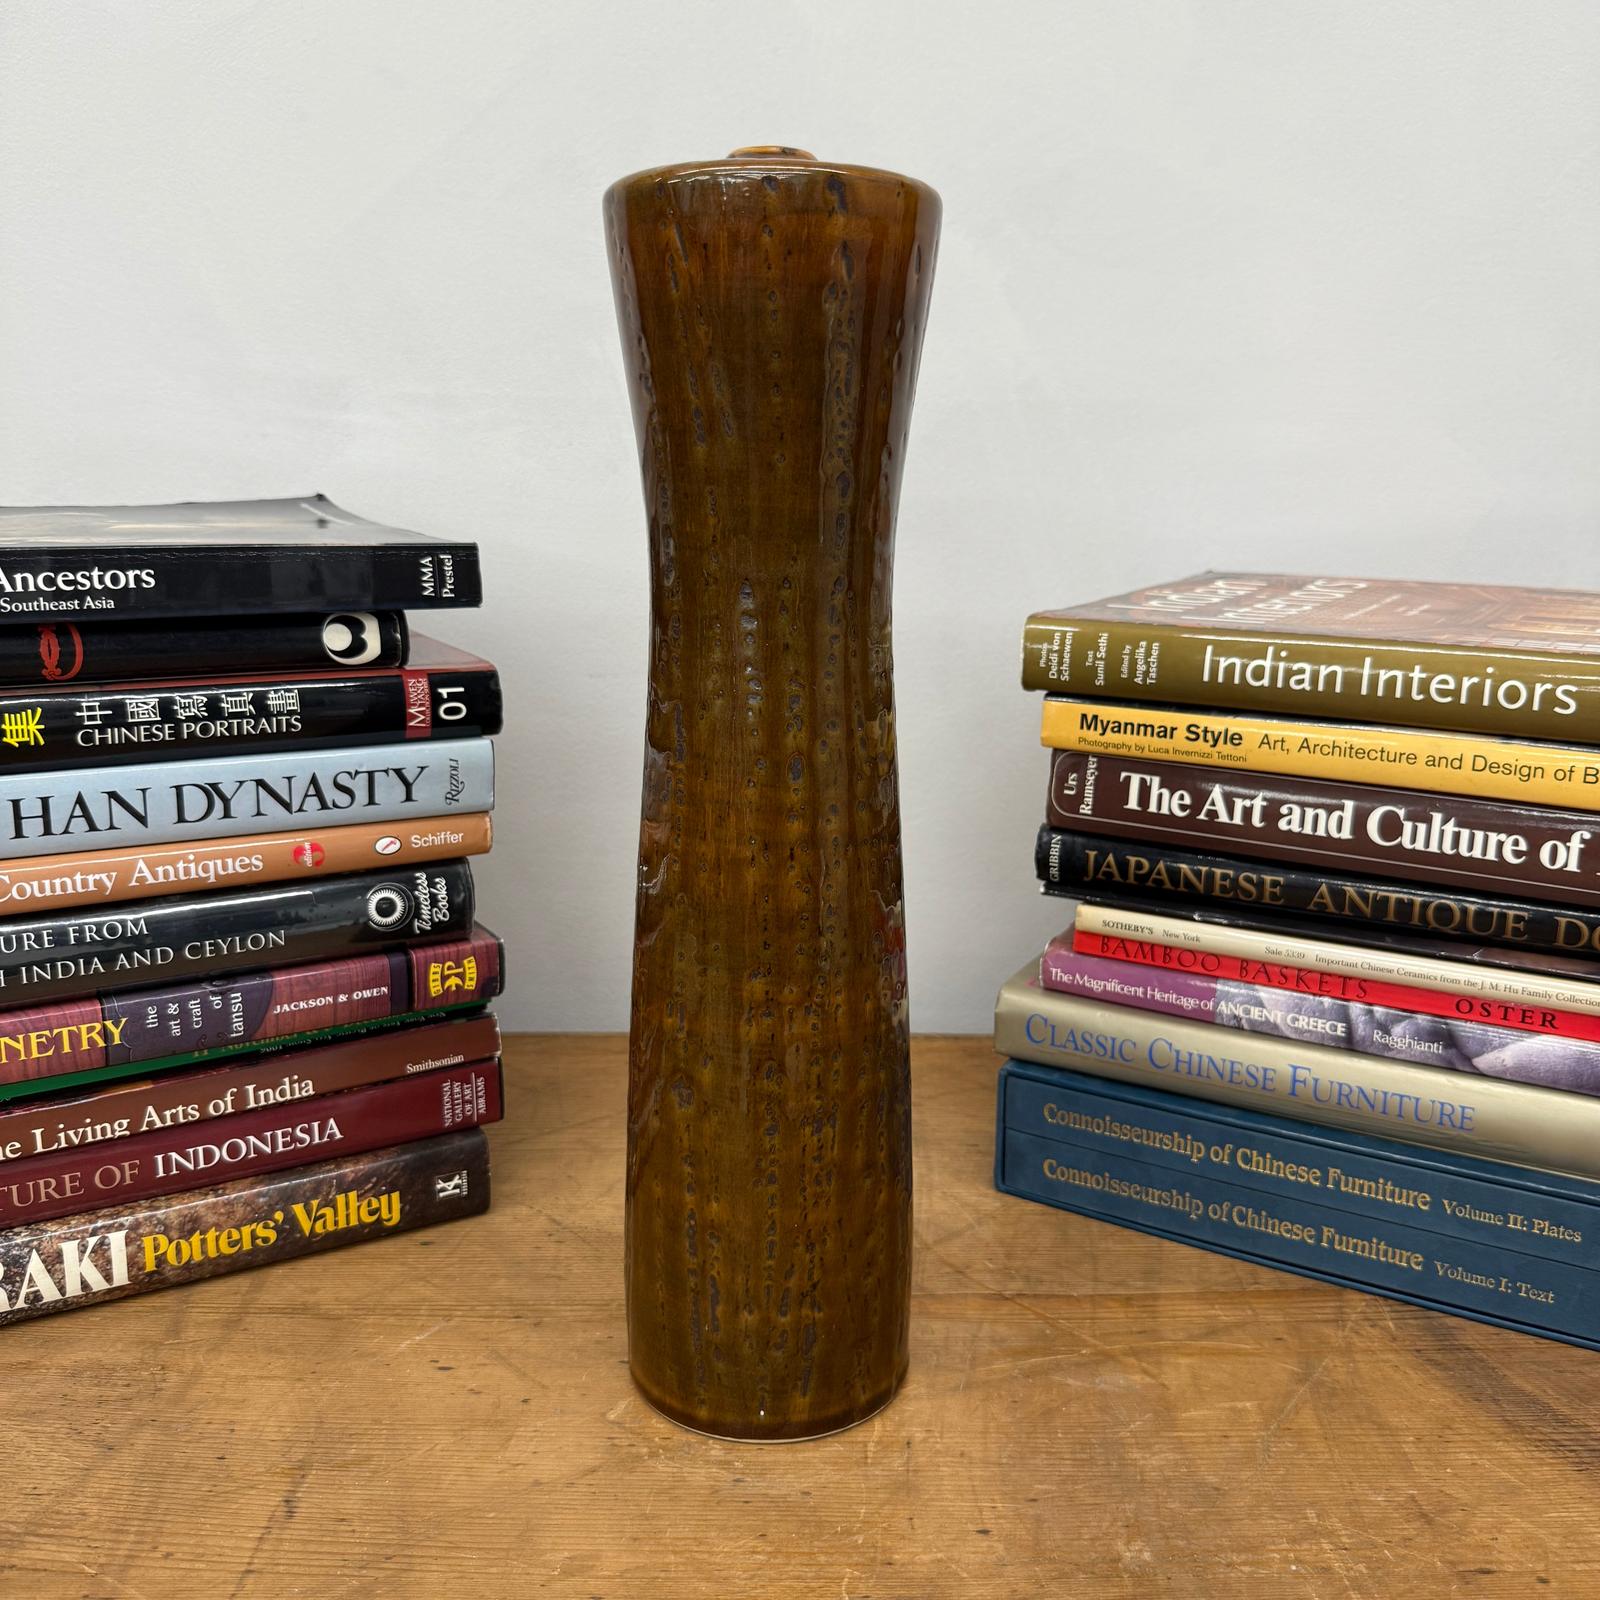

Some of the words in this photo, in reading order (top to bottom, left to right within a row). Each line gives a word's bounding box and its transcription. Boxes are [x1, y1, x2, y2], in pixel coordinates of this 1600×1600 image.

[420, 555, 435, 597] MMA
[439, 553, 455, 598] Prestel
[0, 597, 80, 612] Southeast
[83, 595, 115, 609] Asia
[1052, 632, 1061, 652] von
[1060, 631, 1073, 682] Schaewen
[1096, 632, 1109, 658] Sethi
[1134, 640, 1147, 685] Angelika
[1048, 653, 1059, 679] Deidi
[1095, 660, 1105, 686] Sunil
[1121, 654, 1130, 679] Edited
[1147, 642, 1160, 686] Taschen
[1201, 645, 1343, 694] Indian
[1360, 656, 1579, 716] Interiors
[437, 686, 467, 720] 01
[1, 707, 45, 748] 集
[76, 723, 175, 748] CHINESE
[184, 715, 302, 740] PORTRAITS
[1079, 713, 1178, 740] Myanmar
[1185, 723, 1244, 748] Style
[1078, 737, 1132, 752] Photography
[1134, 740, 1146, 753] by
[1147, 744, 1170, 755] Luca
[1172, 746, 1213, 760] Invernizzi
[1215, 751, 1248, 763] Tettoni
[1258, 733, 1290, 754] Art,
[1298, 737, 1418, 766] Architecture
[1425, 753, 1463, 770] and
[1471, 754, 1545, 783] Design
[1554, 765, 1576, 783] of
[8, 787, 153, 840] HAN
[169, 765, 430, 826] DYNASTY
[1063, 772, 1078, 797] Urs
[1079, 755, 1099, 816] Ramseyer
[411, 831, 464, 848] Schiffer
[1120, 771, 1193, 818] The
[1196, 783, 1268, 827] Art
[1277, 799, 1354, 840] and
[1366, 804, 1528, 864] Culture
[1539, 830, 1592, 873] of
[129, 854, 264, 887] Antiques
[1050, 833, 1063, 882] GRIBBIN
[414, 871, 433, 934] Timeless
[430, 877, 450, 922] Books
[1083, 849, 1285, 905] JAPANESE
[1307, 883, 1529, 940] ANTIQUE
[1552, 915, 1600, 951] D
[0, 929, 55, 953] URE
[68, 918, 150, 946] FROM
[1102, 919, 1154, 935] SOTHEBY'S
[1162, 929, 1181, 940] New
[1182, 932, 1200, 944] York
[21, 957, 105, 984] INDIA
[115, 946, 175, 971] AND
[185, 930, 286, 960] CEYLON
[1101, 935, 1221, 972] BAMBOO
[1239, 959, 1367, 999] BASKETS
[1264, 945, 1284, 957] Sale
[1315, 953, 1359, 969] Important
[1360, 960, 1395, 975] Chinese
[1397, 967, 1438, 982] Ceramics
[1439, 974, 1461, 986] from
[1463, 976, 1478, 988] the
[1503, 983, 1519, 995] Hu
[1521, 986, 1553, 1002] Family
[145, 1004, 158, 1029] the
[168, 1003, 180, 1015] &
[188, 998, 202, 1029] craft
[208, 995, 222, 1010] of
[229, 992, 243, 1038] tansu
[273, 996, 334, 1014] JACKSON
[338, 992, 349, 1003] &
[353, 985, 389, 1001] OWEN
[1050, 967, 1073, 984] The
[1074, 972, 1145, 999] Magnificent
[1147, 985, 1200, 1011] Heritage
[1200, 996, 1216, 1011] of
[1216, 999, 1285, 1025] ANCIENT
[1286, 1013, 1347, 1037] GREECE
[1455, 998, 1559, 1029] OSTER
[171, 1018, 181, 1037] art
[1373, 1029, 1443, 1054] Ragghianti
[406, 1054, 464, 1073] Smithsonian
[1024, 1013, 1136, 1063] CLASSIC
[1147, 1036, 1277, 1092] CHINESE
[1288, 1063, 1476, 1132] FURNITURE
[442, 1078, 453, 1128] NATIONAL
[453, 1081, 464, 1122] GALLERY
[464, 1082, 473, 1101] ART
[464, 1102, 474, 1116] OF
[476, 1076, 487, 1114] ABRAMS
[32, 1117, 130, 1155] Living
[140, 1104, 201, 1132] Arts
[208, 1087, 236, 1117] of
[245, 1075, 316, 1110] India
[94, 1159, 140, 1190] OF
[155, 1117, 344, 1179] INDONESIA
[1043, 1103, 1205, 1163] Connoisseurship
[1210, 1143, 1233, 1165] of
[1236, 1148, 1321, 1186] Chinese
[1327, 1167, 1431, 1211] Furniture
[1442, 1199, 1503, 1226] Volume
[1507, 1212, 1529, 1231] II:
[1531, 1218, 1582, 1243] Plates
[142, 1210, 284, 1273] Potters'
[292, 1190, 401, 1239] Valley
[1043, 1159, 1204, 1220] Connoisseurship
[1208, 1201, 1232, 1222] of
[1232, 1205, 1316, 1244] Chinese
[1320, 1226, 1424, 1270] Furniture
[1433, 1260, 1495, 1291] Volume
[1516, 1281, 1555, 1304] Text
